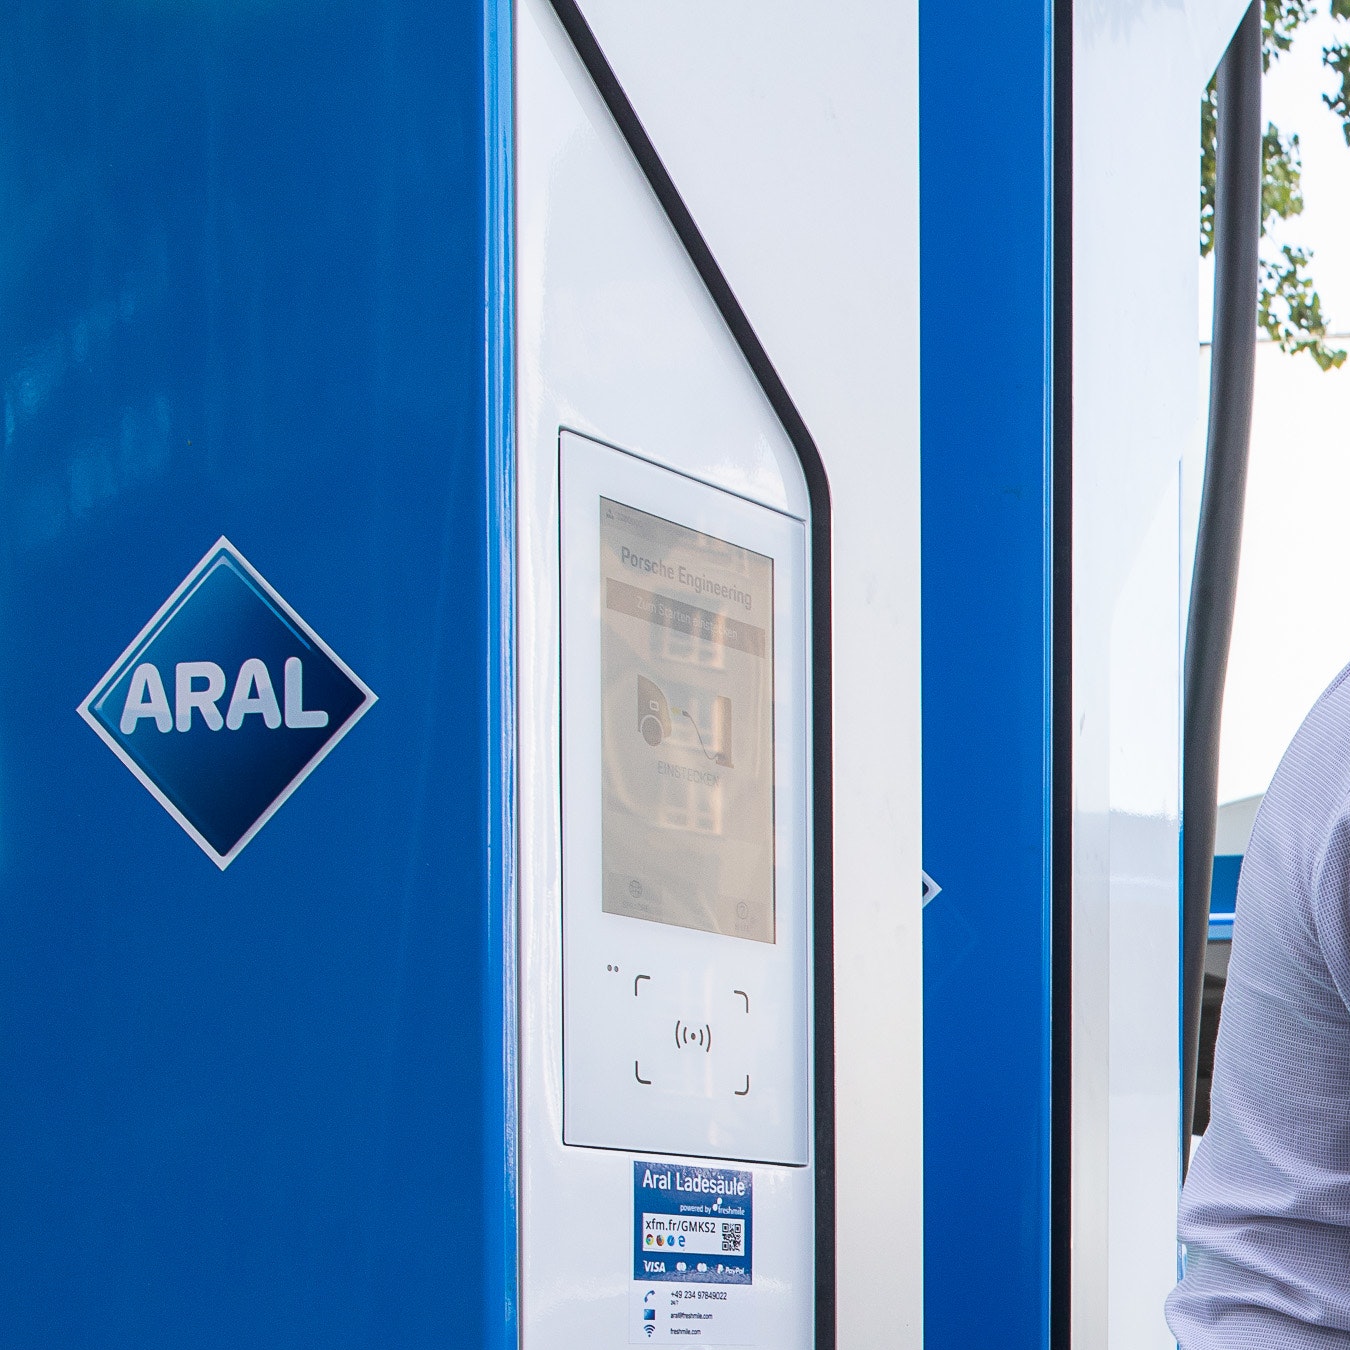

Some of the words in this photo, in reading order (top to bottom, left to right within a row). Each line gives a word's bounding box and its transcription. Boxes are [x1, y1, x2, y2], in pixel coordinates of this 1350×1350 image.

[621, 546, 674, 580] Porsche
[678, 566, 752, 610] Engineering
[637, 596, 656, 613] Zum
[658, 603, 690, 623] Starten
[120, 656, 329, 735] ARAL
[657, 761, 720, 787] EINSTECKEN
[642, 1169, 671, 1190] Aral
[676, 1172, 745, 1196] Ladesäule
[680, 1204, 704, 1213] powered
[704, 1205, 712, 1215] by
[718, 1205, 745, 1216] freshmile
[645, 1218, 716, 1234] xfm.fr/GMKS2
[643, 1260, 666, 1273] VISA
[725, 1266, 745, 1275] PayPal
[671, 1290, 683, 1299] +49
[684, 1290, 696, 1299] 234
